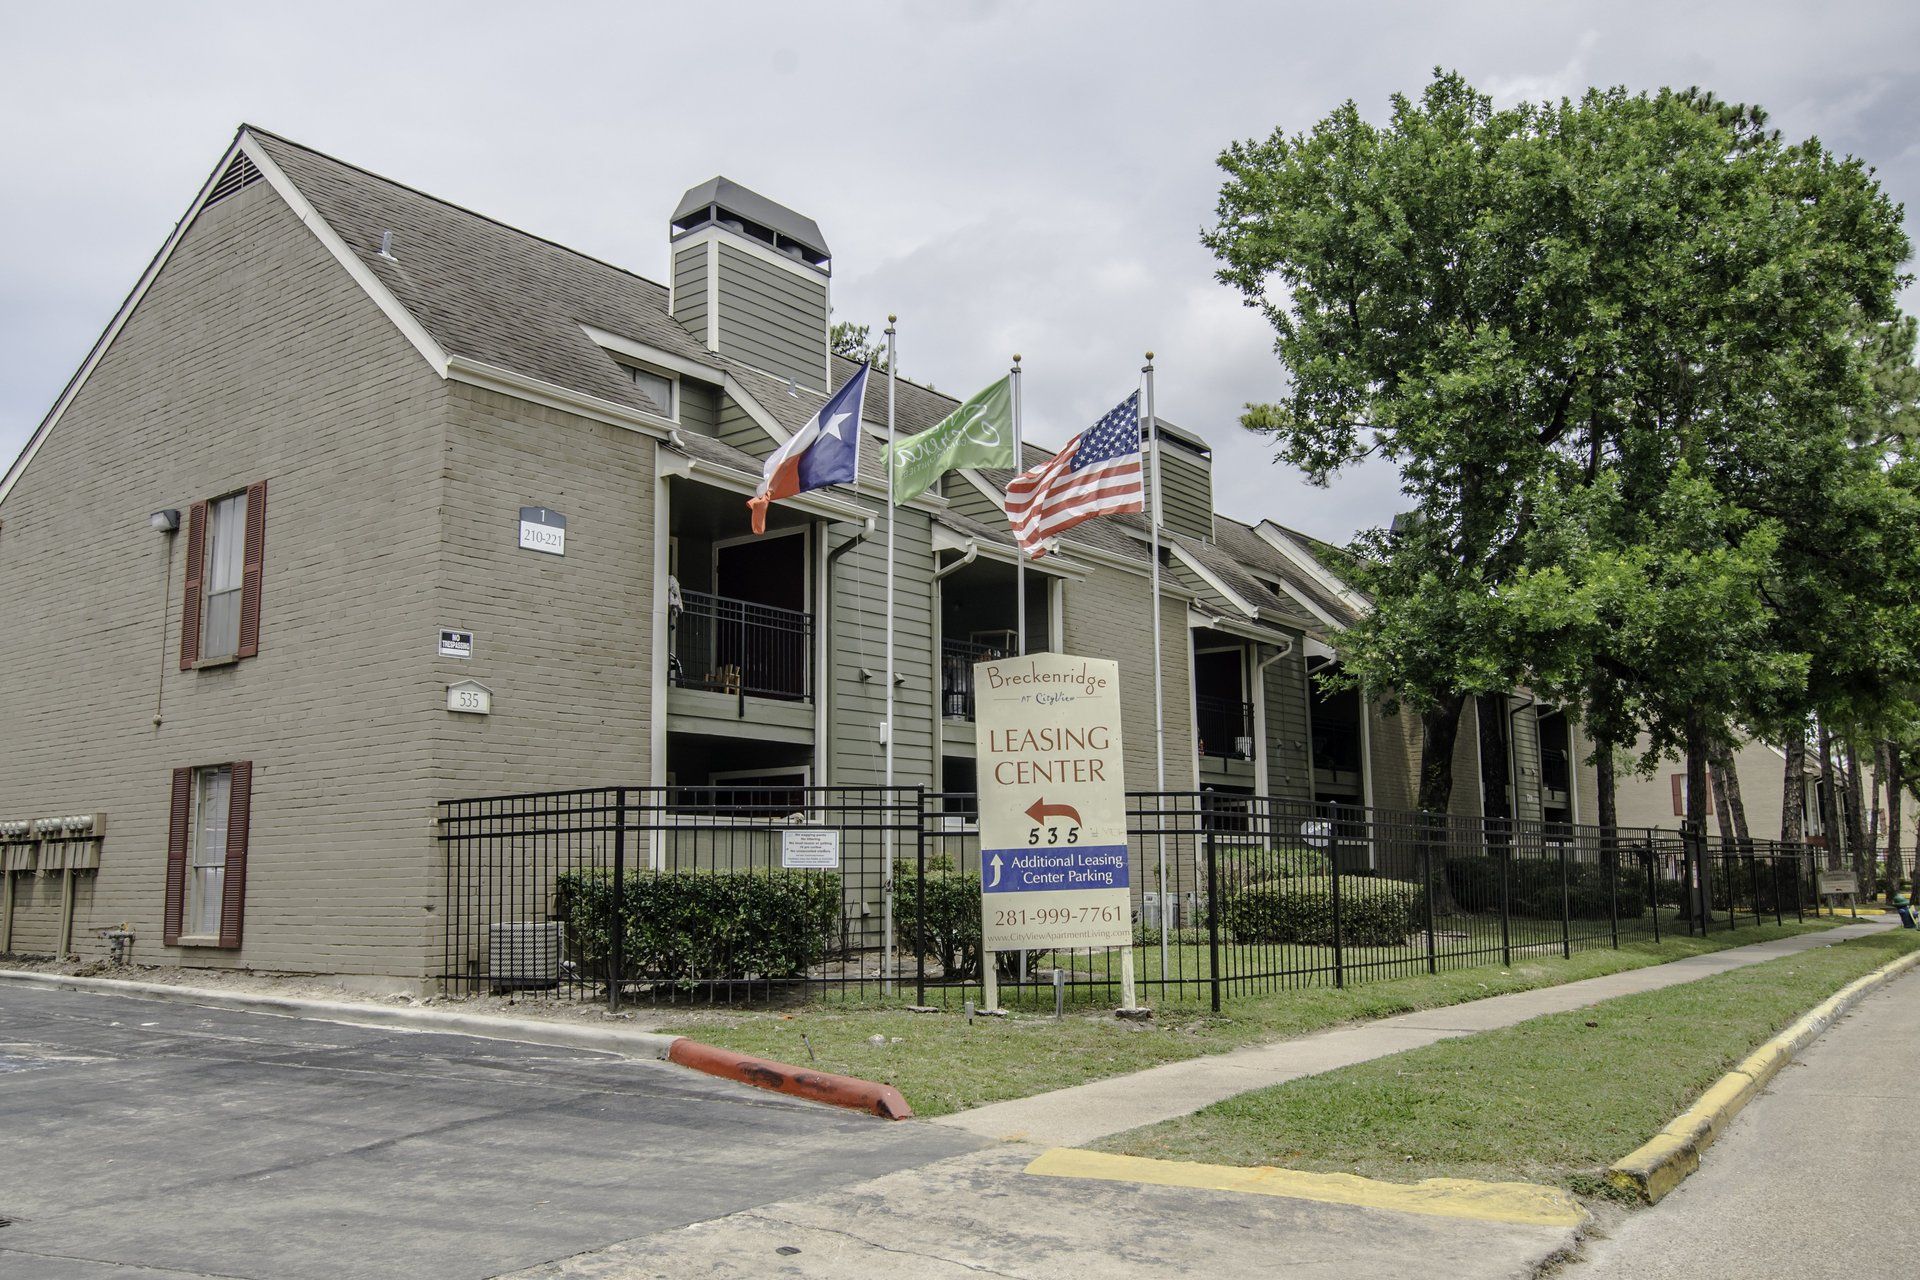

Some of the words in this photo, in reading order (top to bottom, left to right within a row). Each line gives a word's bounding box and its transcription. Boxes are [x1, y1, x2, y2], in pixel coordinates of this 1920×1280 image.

[541, 510, 545, 522] 1
[524, 529, 562, 547] 210-221
[442, 640, 470, 650] TRESPASSING
[451, 633, 461, 642] NO
[987, 661, 1107, 695] Breckenridge
[459, 692, 479, 708] 535
[990, 726, 1109, 753] LEASING
[994, 759, 1106, 785] CENTER
[1011, 855, 1074, 869] Additional
[1078, 854, 1123, 868] Leasing
[1023, 871, 1064, 884] Center
[1068, 870, 1113, 884] Parking
[995, 905, 1121, 926] 281-999-7761
[987, 929, 1130, 942] www.CityViewApartmentLiving.com
